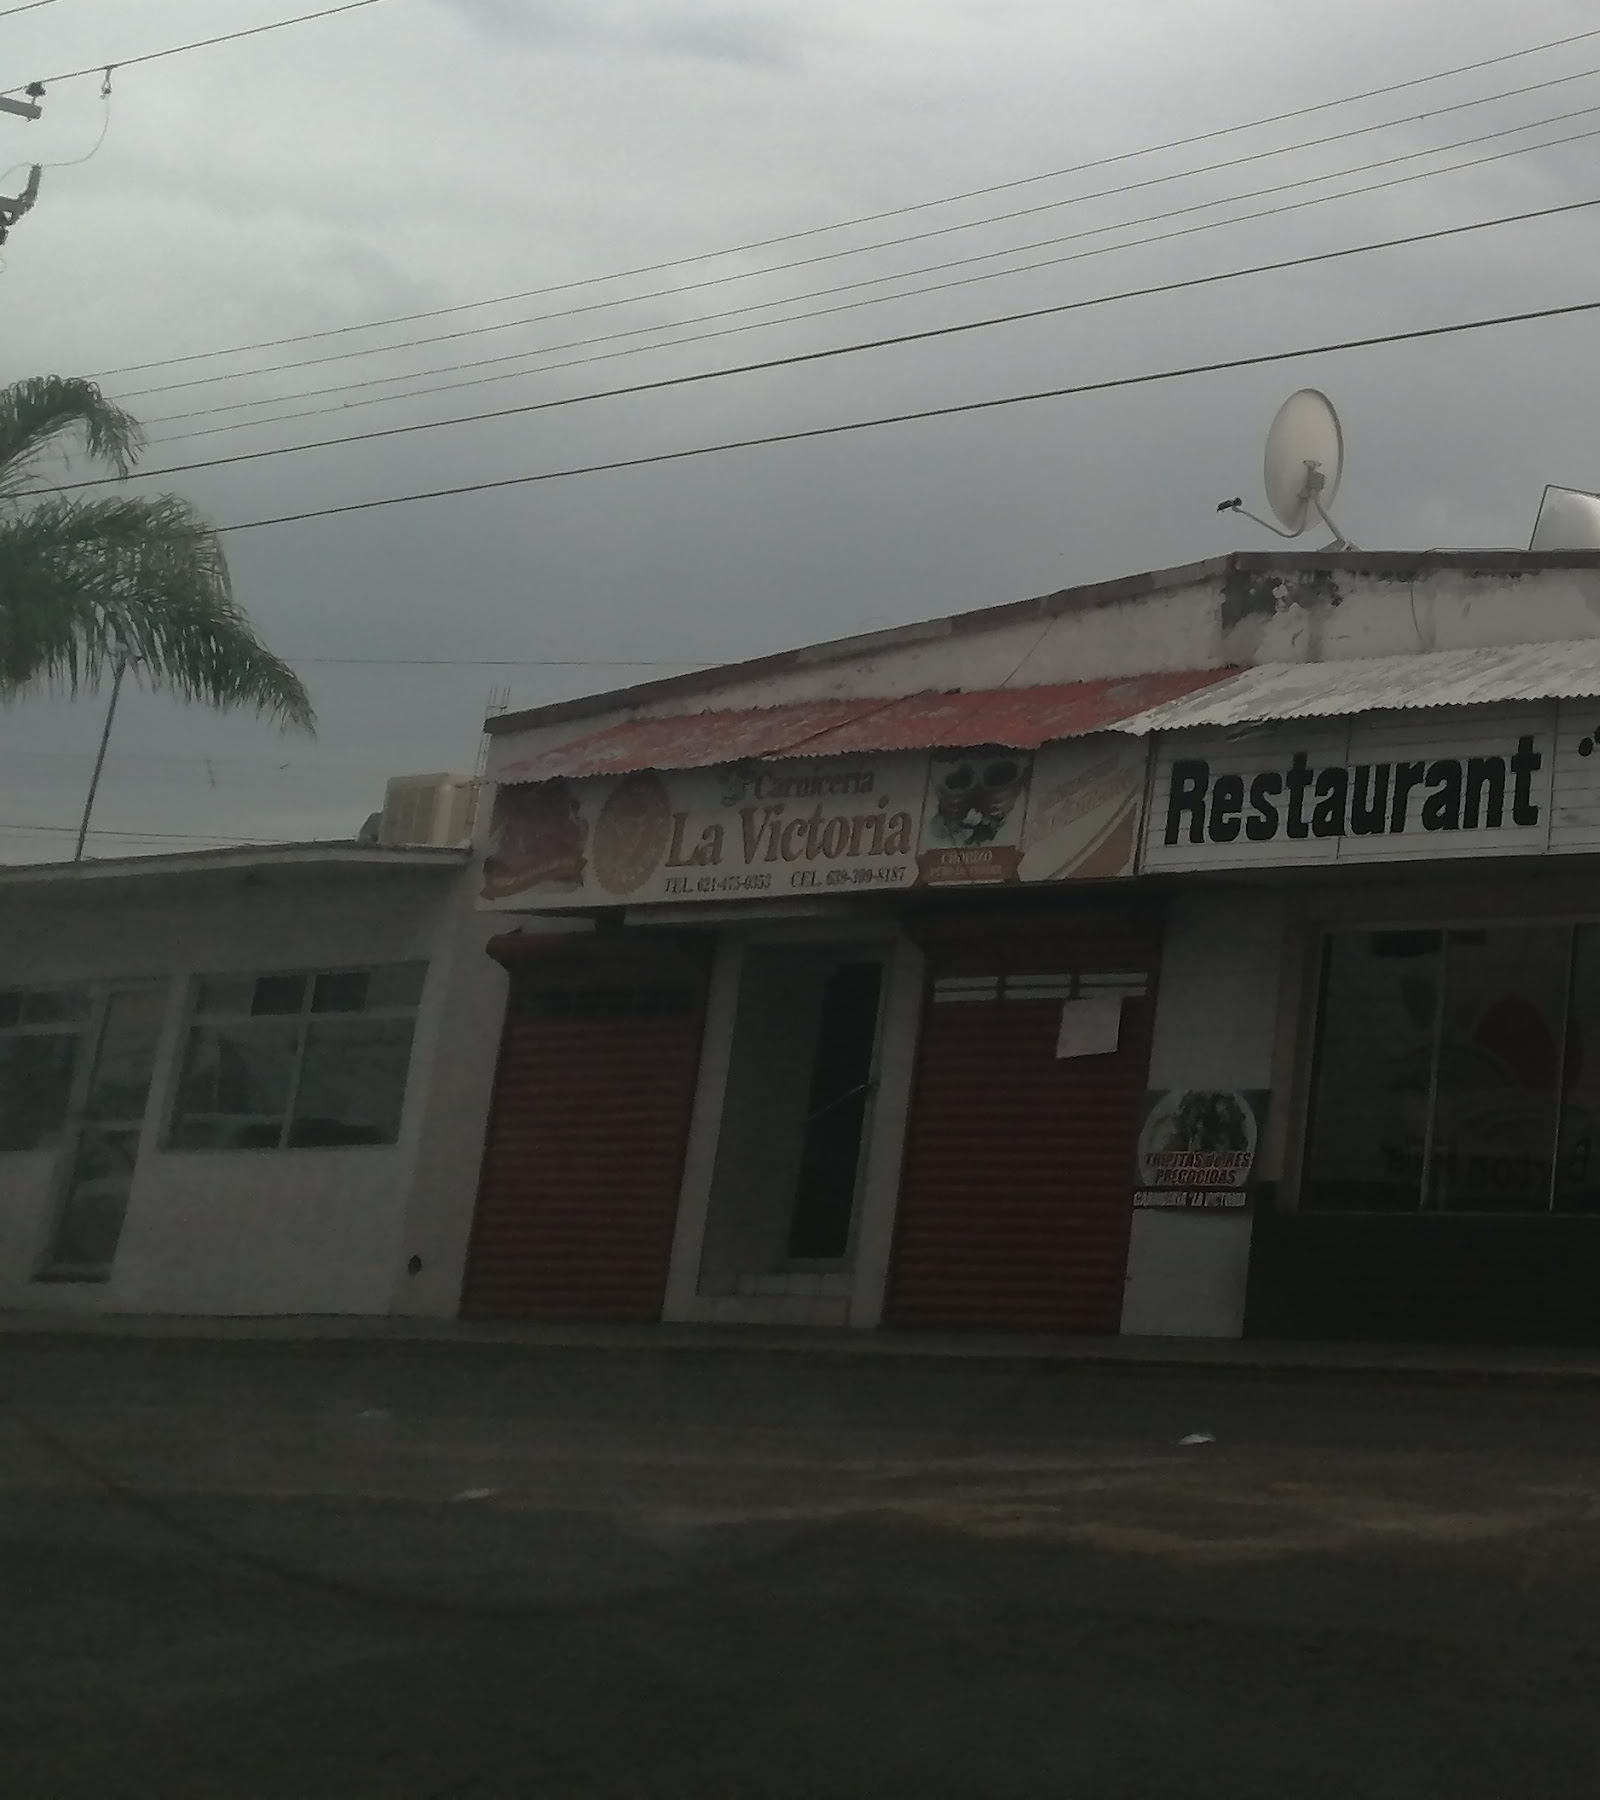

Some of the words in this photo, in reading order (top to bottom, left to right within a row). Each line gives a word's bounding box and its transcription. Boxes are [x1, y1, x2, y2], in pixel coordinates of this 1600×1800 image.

[665, 811, 725, 868] La
[738, 795, 913, 865] Victoria
[1163, 735, 1543, 845] Restaurant
